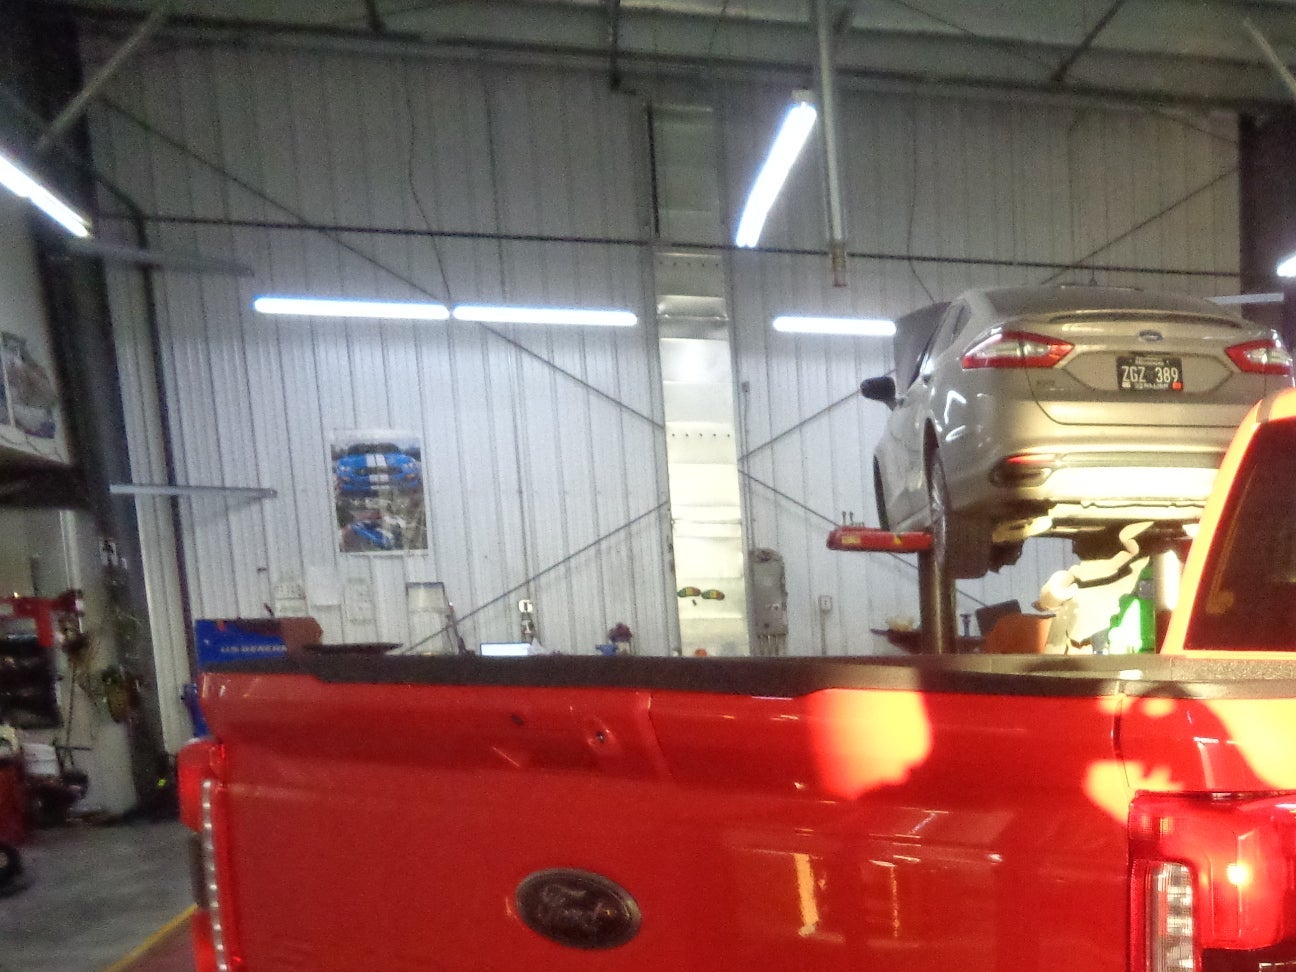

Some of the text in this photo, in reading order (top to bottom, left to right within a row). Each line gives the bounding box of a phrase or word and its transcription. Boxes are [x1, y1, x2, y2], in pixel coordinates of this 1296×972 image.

[1121, 365, 1178, 383] ZGZ 389
[241, 644, 288, 653] GENERA
